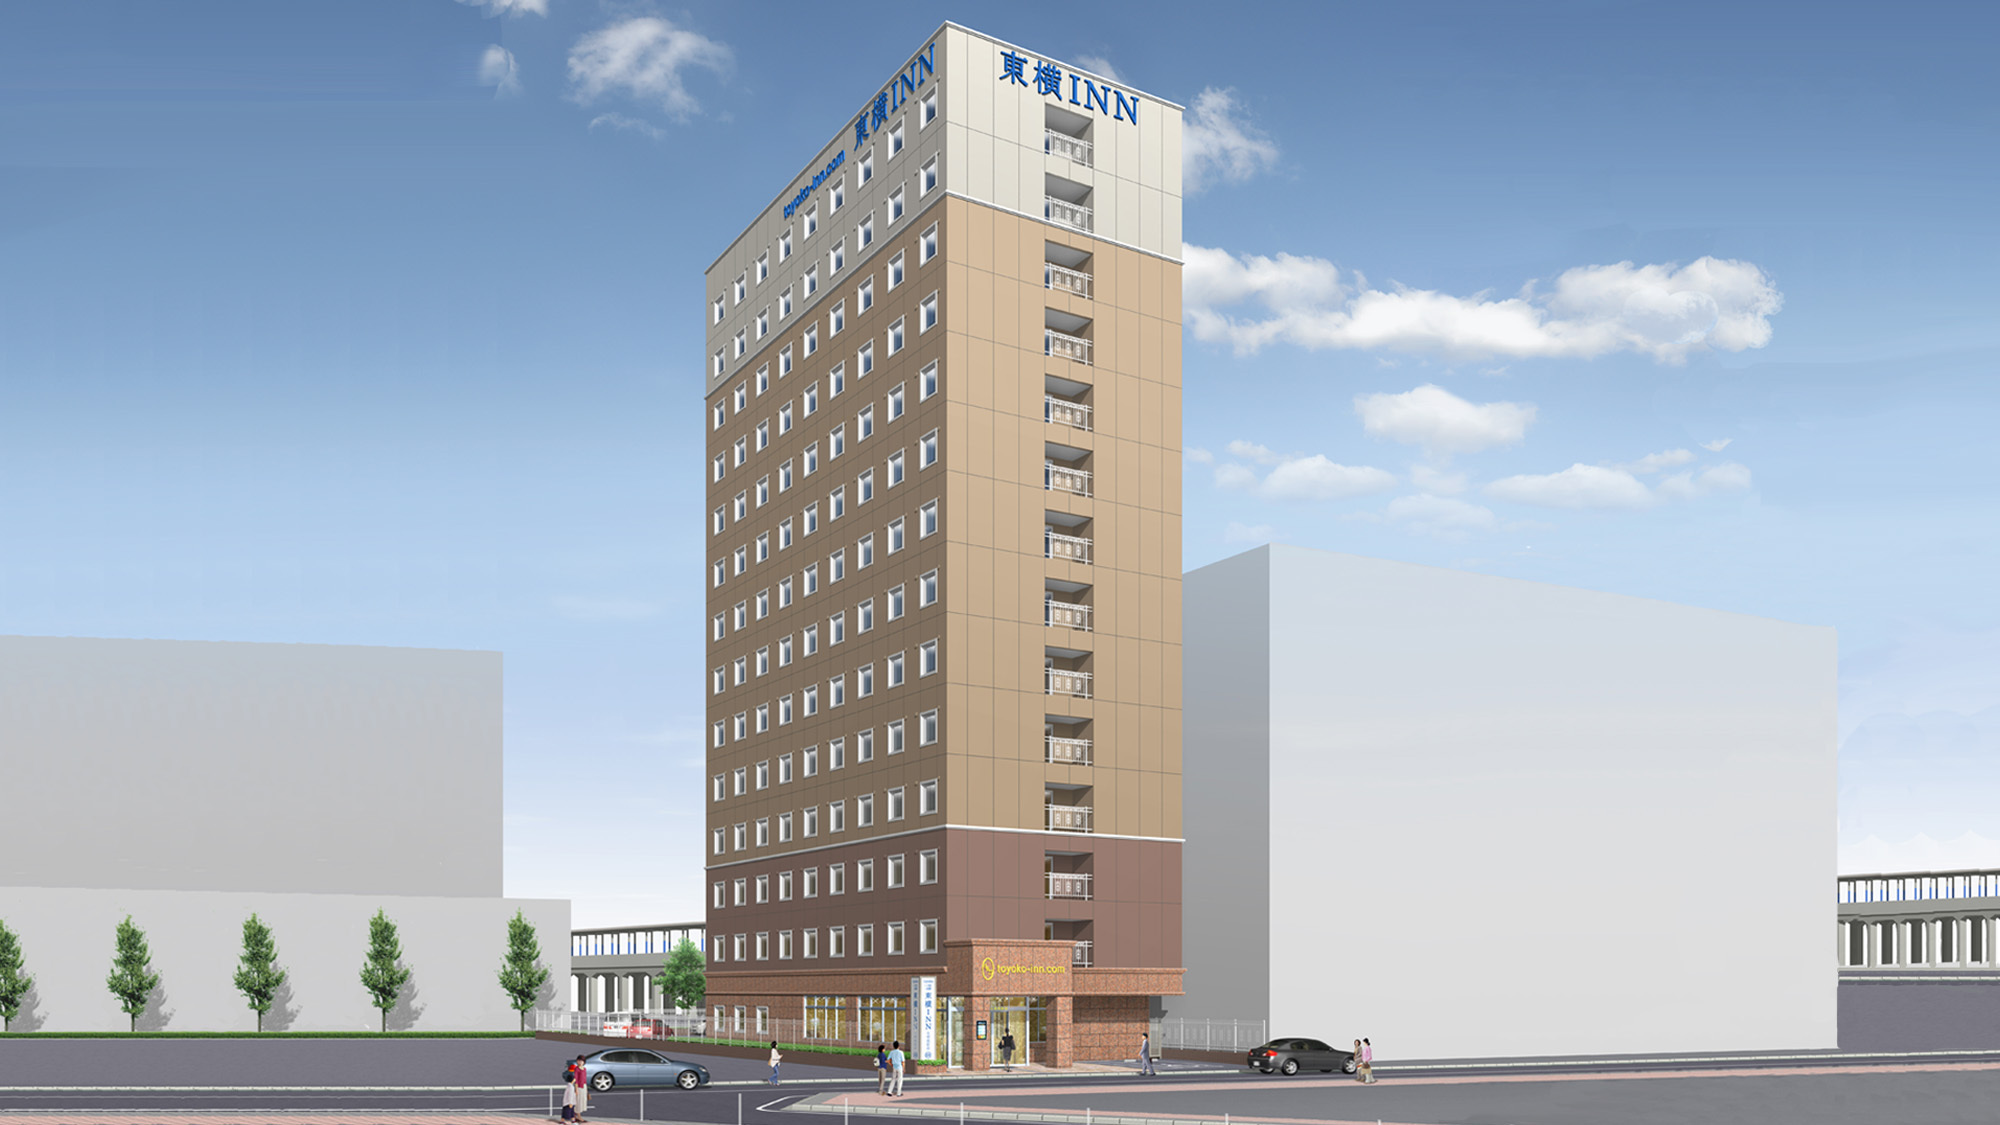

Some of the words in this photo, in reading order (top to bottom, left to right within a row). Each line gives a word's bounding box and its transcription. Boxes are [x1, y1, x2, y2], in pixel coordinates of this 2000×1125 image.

[853, 43, 935, 151] 東横INN
[999, 51, 1140, 125] 東横INN
[784, 150, 845, 219] toyoko-inn.com
[997, 964, 1065, 975] toyoko-inn.com
